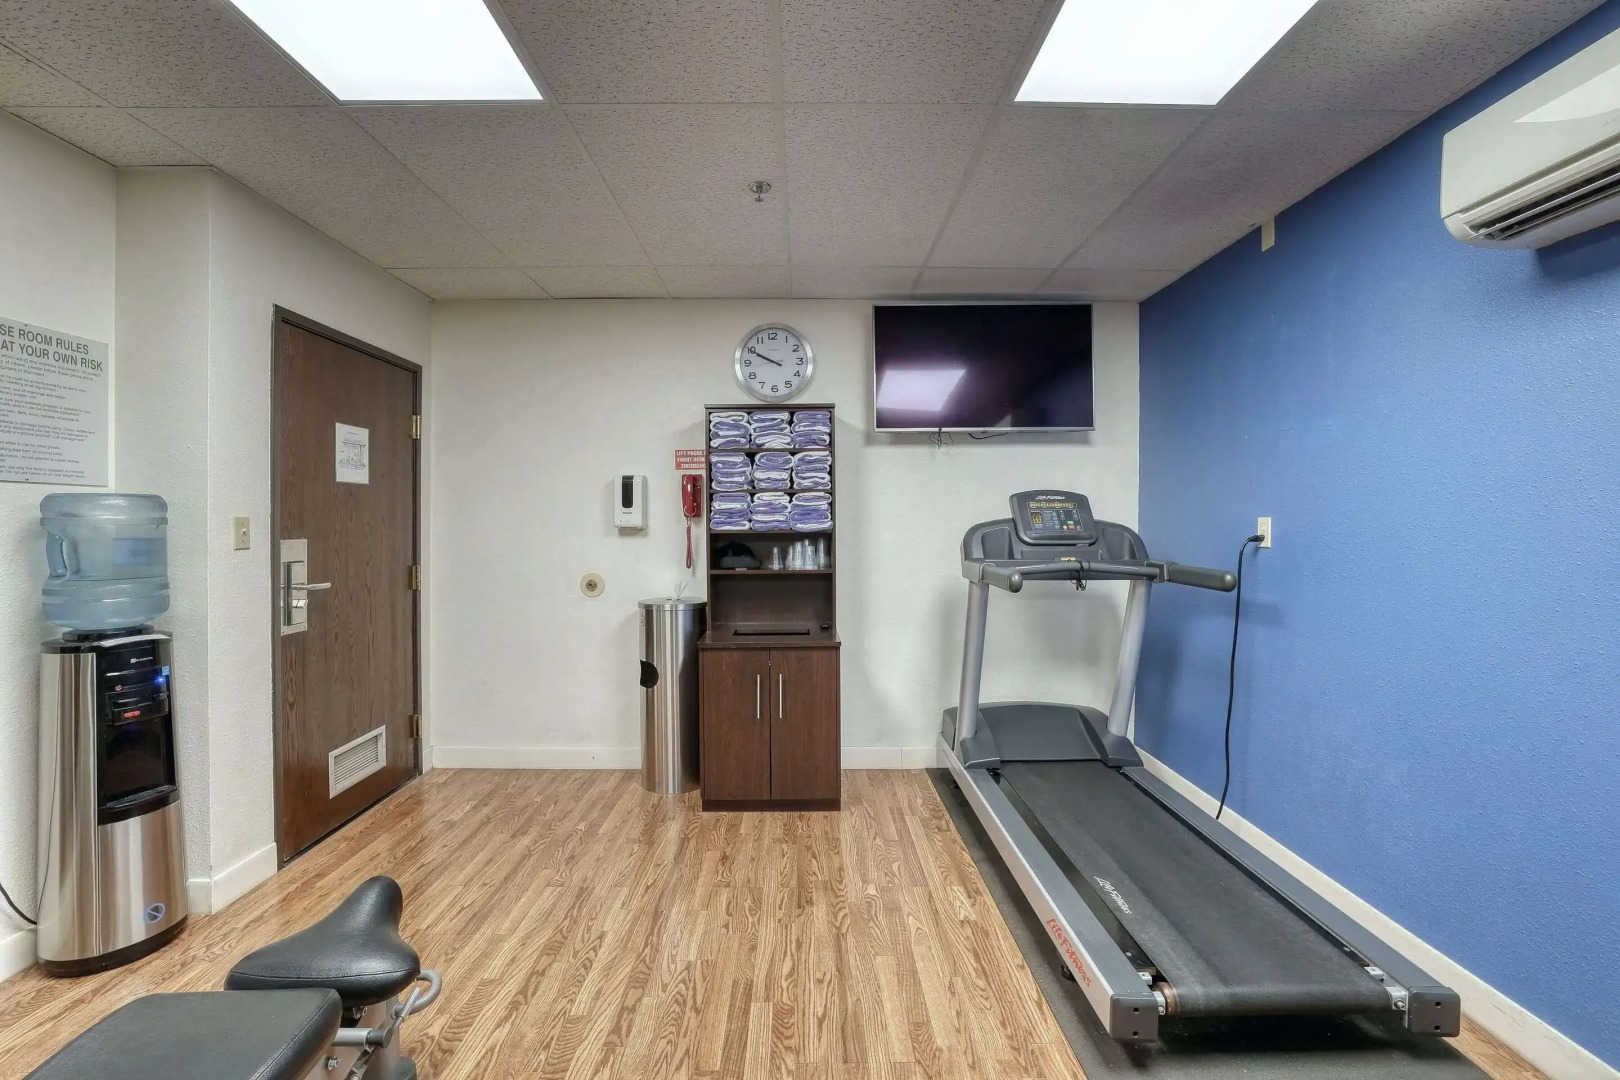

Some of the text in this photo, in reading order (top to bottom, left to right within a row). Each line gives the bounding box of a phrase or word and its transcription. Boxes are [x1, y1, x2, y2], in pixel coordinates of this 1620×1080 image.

[757, 336, 764, 344] 11
[768, 332, 778, 341] 12
[19, 329, 52, 347] ROOM
[56, 338, 89, 355] RULES
[747, 346, 756, 354] 10
[792, 344, 800, 352] 2
[1, 340, 103, 372] AT YOUR OWN RISK
[744, 359, 752, 367] 9
[796, 357, 804, 365] 3
[748, 372, 757, 380] 8
[793, 370, 801, 378] 4
[758, 381, 766, 389] 7
[771, 385, 779, 393] 6
